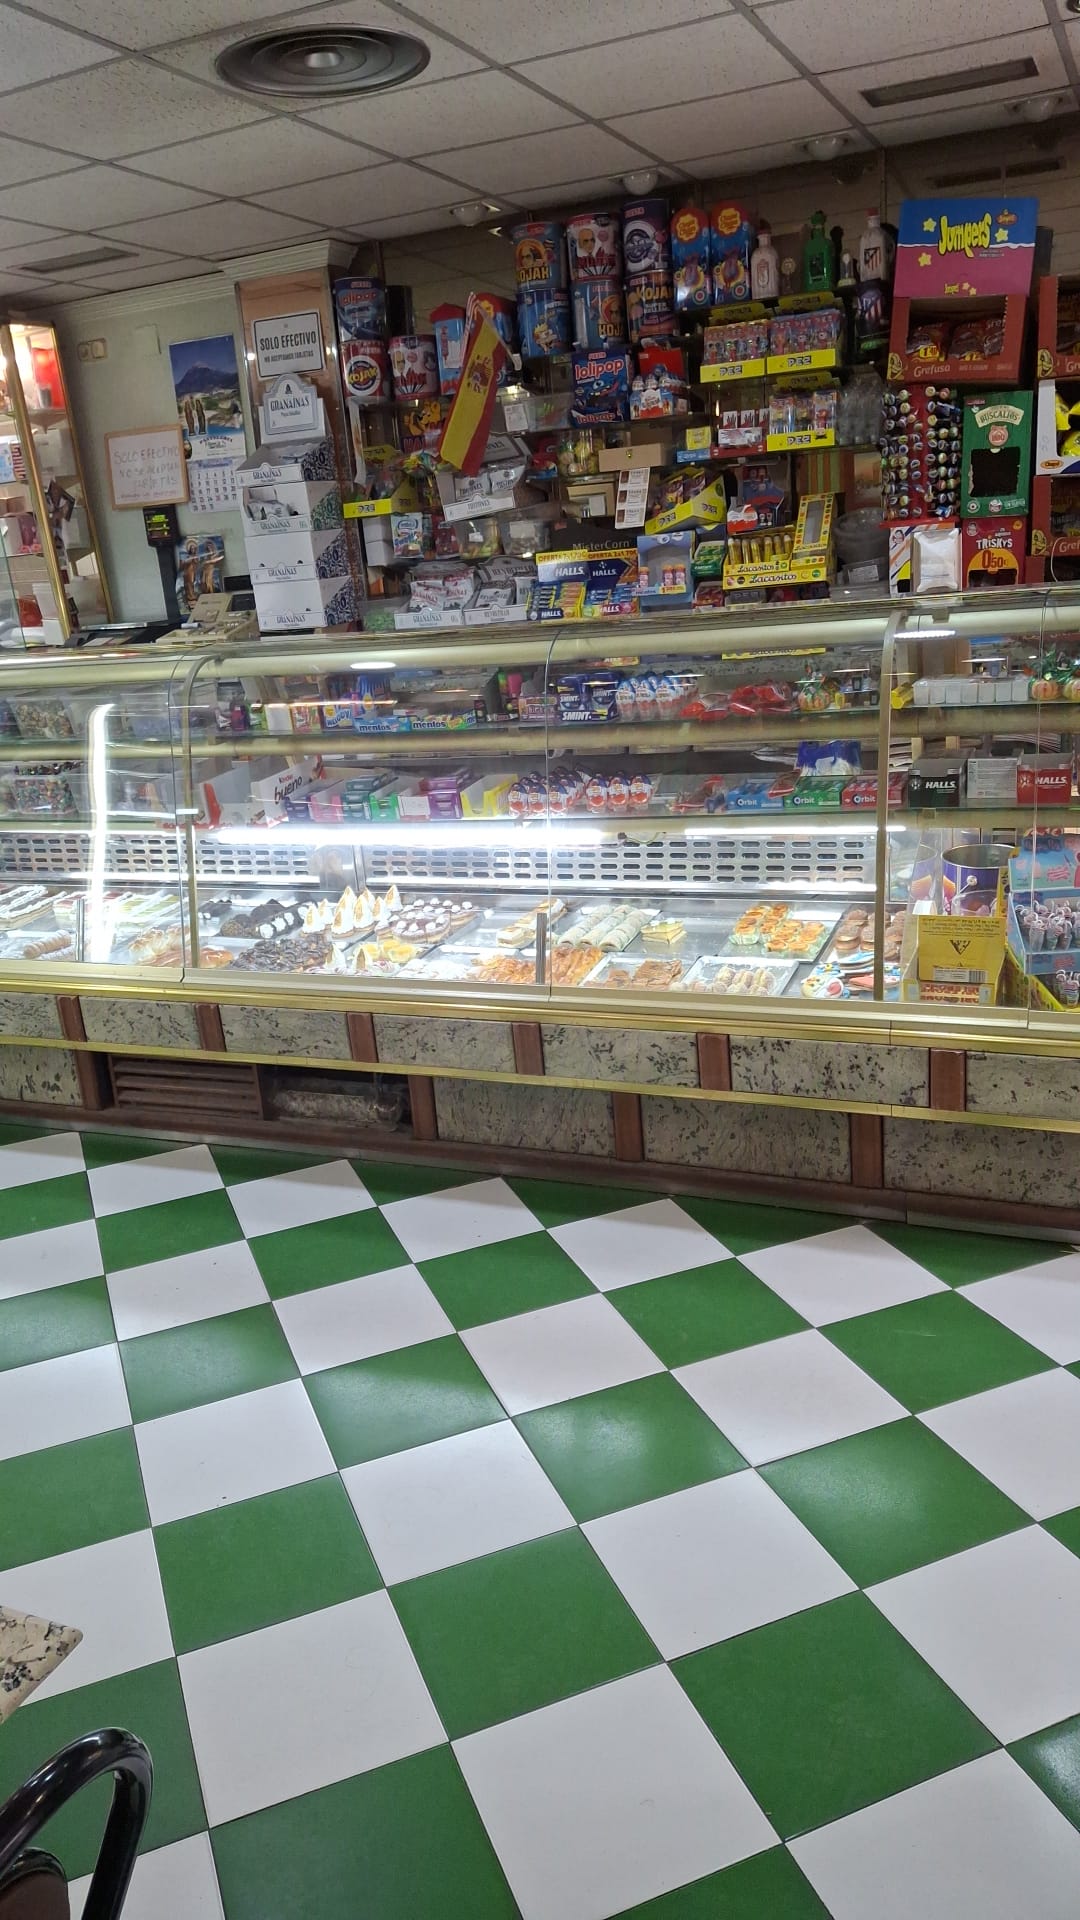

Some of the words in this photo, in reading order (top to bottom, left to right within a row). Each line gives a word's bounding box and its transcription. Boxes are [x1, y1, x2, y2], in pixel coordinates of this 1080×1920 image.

[261, 336, 279, 351] SOLO
[281, 331, 317, 349] EFECTIVO
[787, 355, 811, 367] PEZ
[575, 359, 624, 380] lolipop
[720, 365, 743, 376] PEZ
[787, 435, 811, 444] PEZ
[555, 566, 585, 576] HALLS
[592, 569, 617, 577] HALLS
[749, 574, 797, 584] Lacasitos
[562, 711, 591, 720] SMINT
[359, 724, 391, 732] mentos
[413, 720, 446, 729] mentos
[1035, 776, 1068, 785] HALLS
[737, 798, 757, 806] Orbit
[794, 796, 815, 805] Orbit
[853, 794, 875, 804] Orbit
